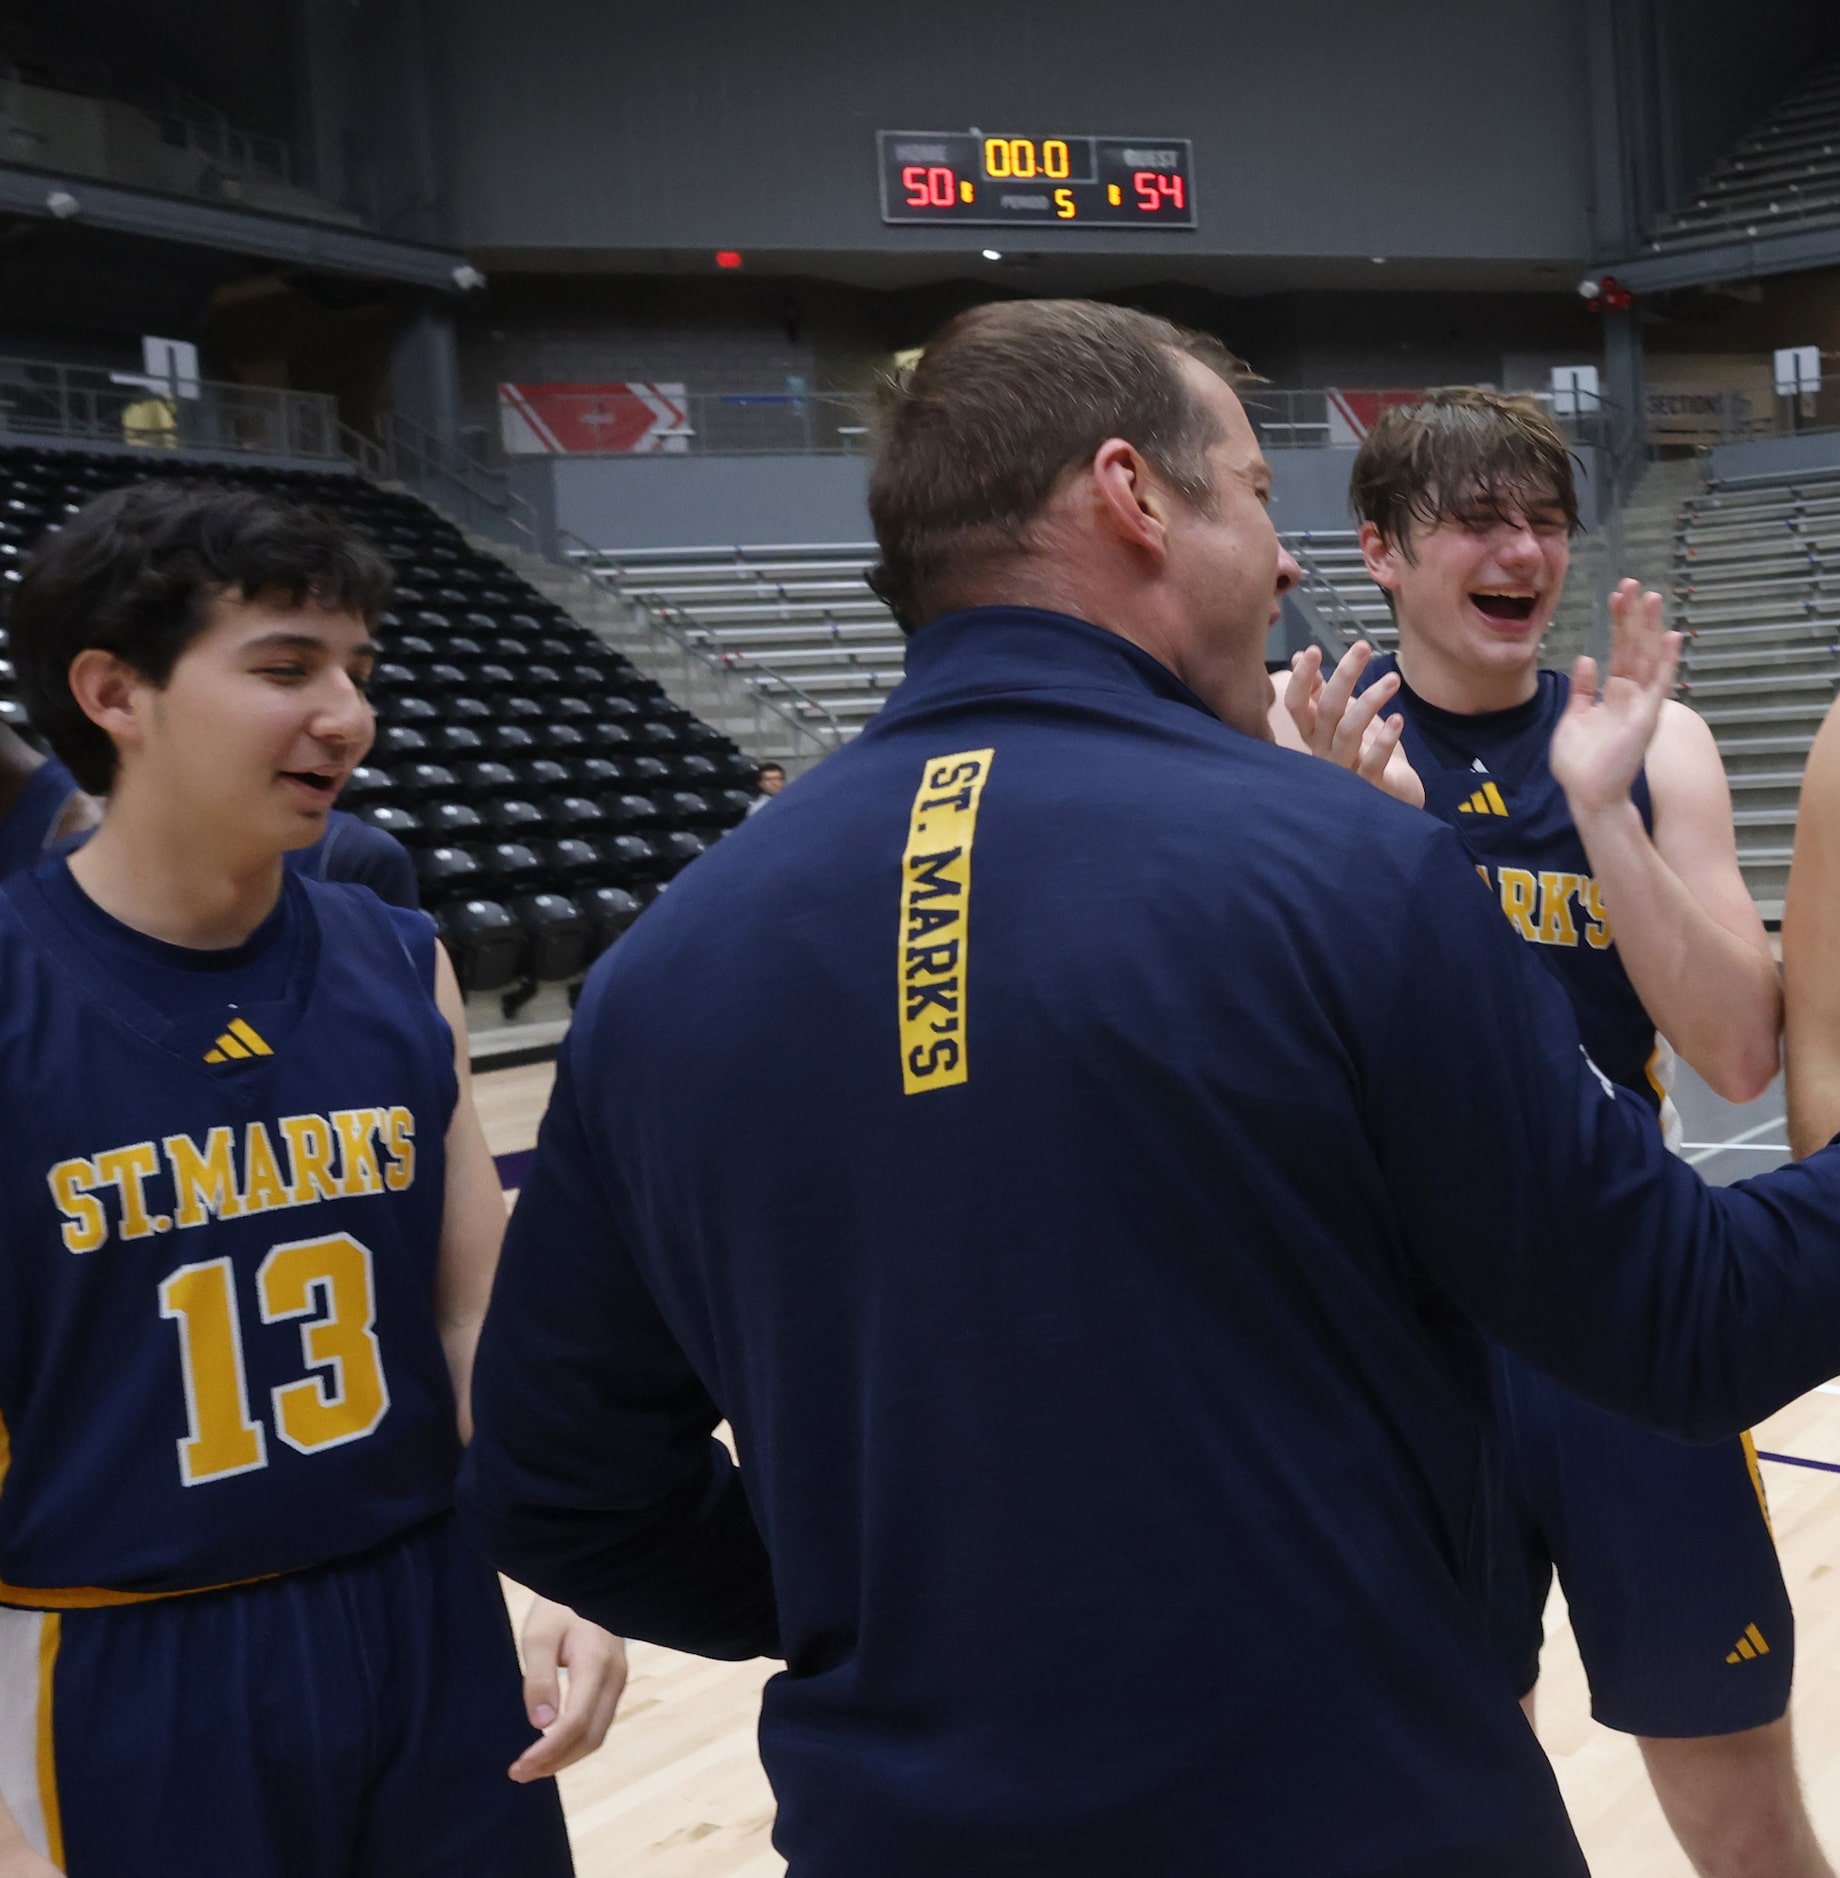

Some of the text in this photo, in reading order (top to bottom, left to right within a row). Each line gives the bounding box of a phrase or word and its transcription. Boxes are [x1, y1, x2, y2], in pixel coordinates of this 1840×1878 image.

[984, 138, 1070, 179] 00.0
[902, 167, 956, 207] 50
[1053, 188, 1077, 219] 5
[1133, 172, 1185, 210] 54
[905, 759, 982, 1079] ST. MARK'S
[157, 1230, 391, 1488] 13
